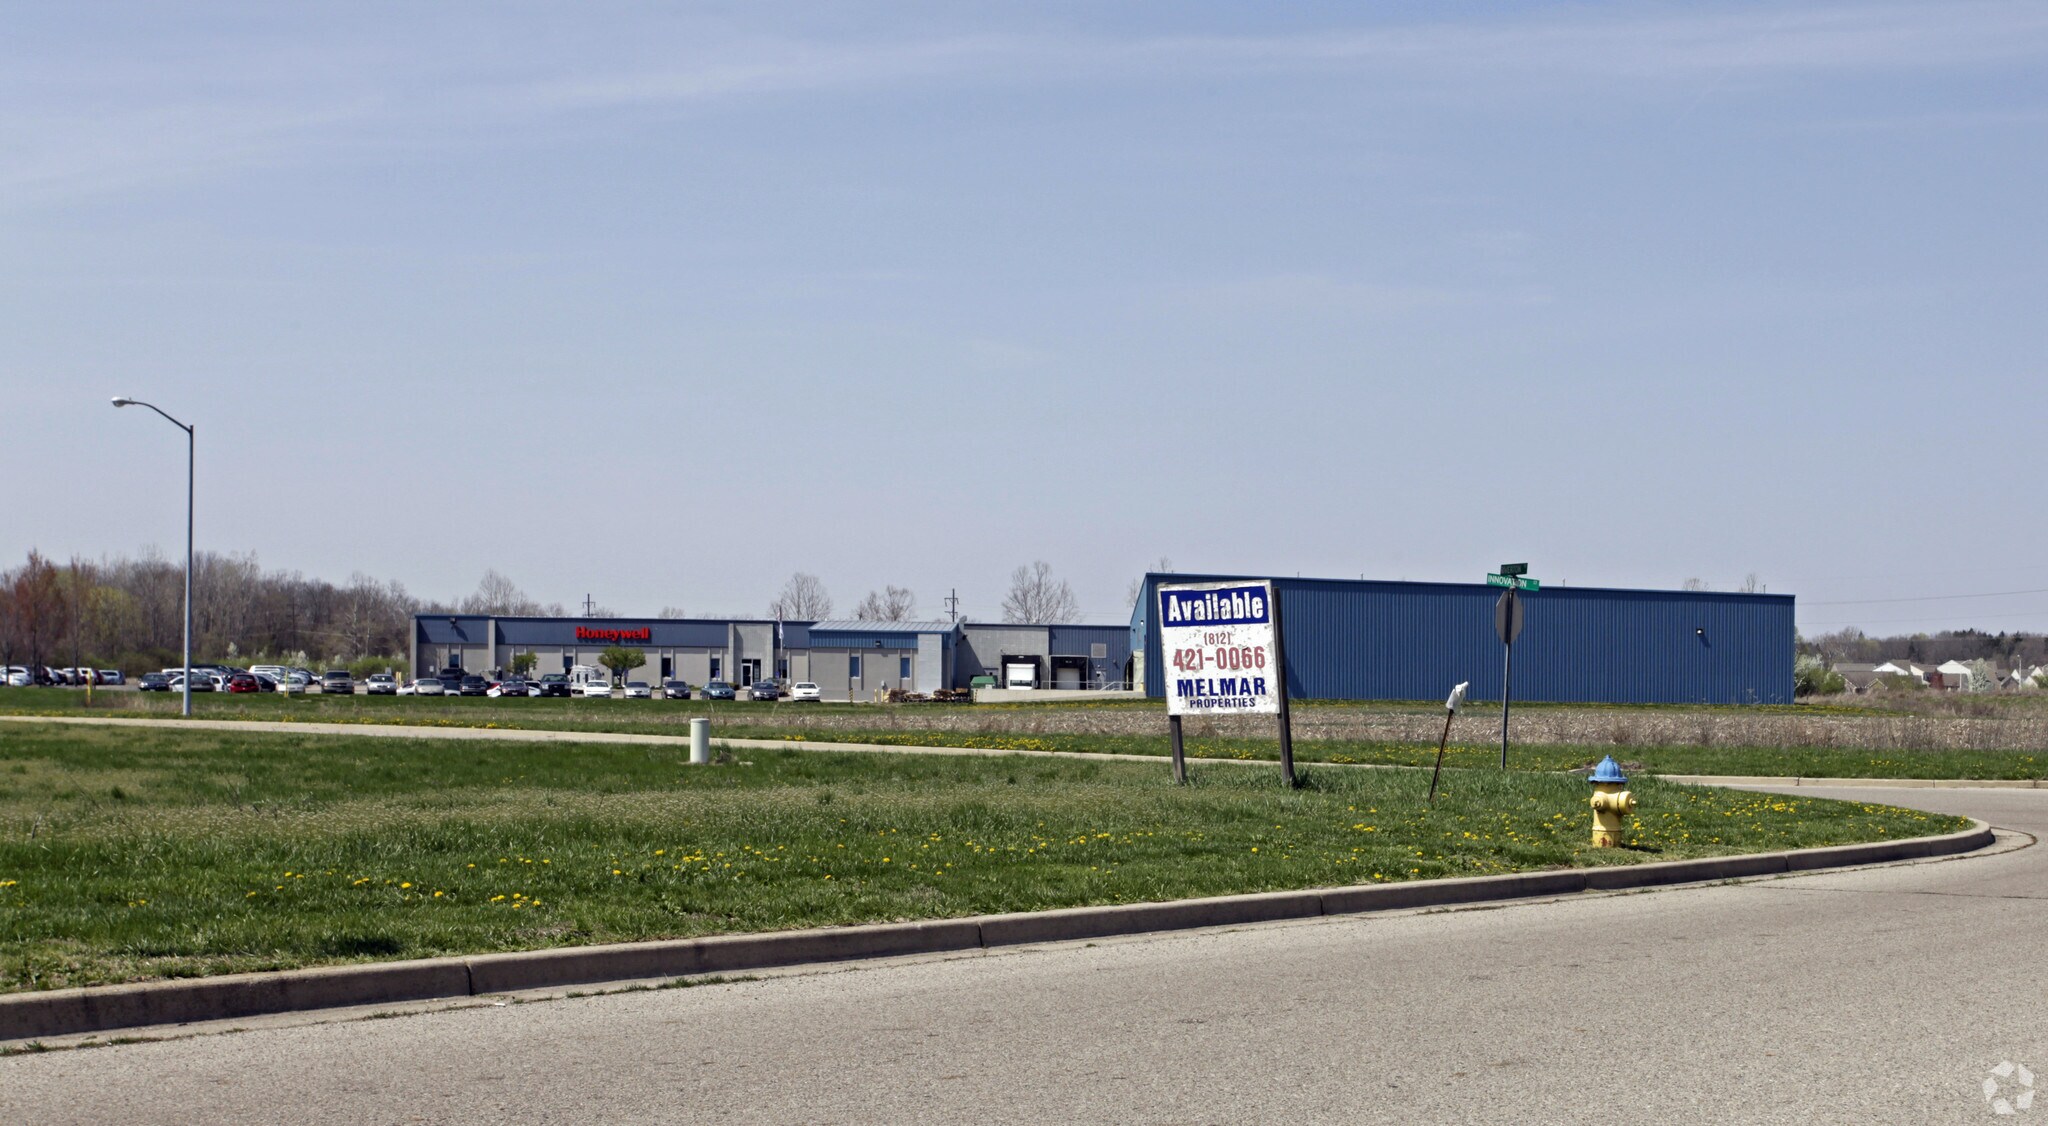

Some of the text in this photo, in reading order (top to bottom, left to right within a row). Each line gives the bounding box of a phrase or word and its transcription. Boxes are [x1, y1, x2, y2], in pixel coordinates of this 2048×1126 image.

[1487, 575, 1527, 588] INNOVATON
[1168, 591, 1264, 621] Available
[575, 626, 650, 641] Honeywell
[1203, 632, 1231, 645] (812)
[1173, 646, 1265, 671] 421-0066
[1177, 677, 1266, 697] MELMAR
[1190, 697, 1256, 708] PROPERTIES
